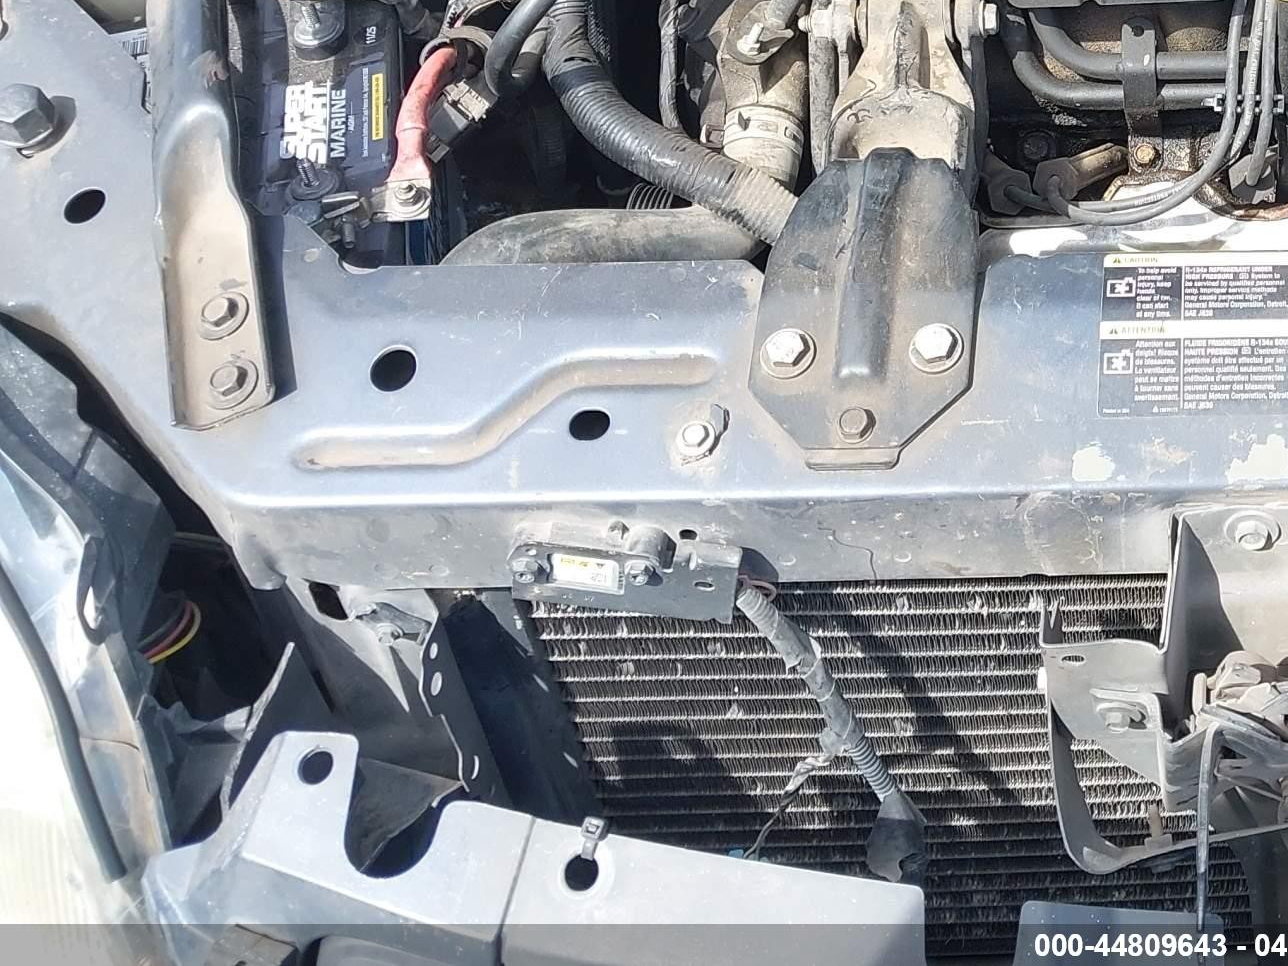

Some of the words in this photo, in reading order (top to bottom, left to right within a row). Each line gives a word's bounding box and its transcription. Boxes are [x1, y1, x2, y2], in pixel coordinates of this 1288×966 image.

[280, 84, 306, 159] SUPER
[303, 80, 328, 164] START
[330, 89, 346, 158] MARINE
[1146, 267, 1160, 275] help
[1251, 273, 1273, 281] System
[1220, 280, 1228, 288] by
[1228, 280, 1255, 288] qualified
[1199, 287, 1227, 295] Improper
[1185, 294, 1198, 302] may
[1230, 301, 1266, 309] Corporation,
[1143, 311, 1155, 319] any
[1184, 309, 1197, 317] SAE
[1136, 340, 1163, 348] Attention
[1164, 340, 1176, 348] aux
[1184, 347, 1206, 355] HAUTE
[1206, 347, 1239, 355] PRESSION
[1211, 356, 1224, 364] doit
[1264, 357, 1275, 366] par
[1275, 356, 1285, 364] un
[1184, 366, 1215, 374] personnel
[1134, 376, 1149, 384] peut
[1249, 374, 1285, 382] incorrectes
[1184, 384, 1210, 392] peuvent
[1231, 383, 1244, 391] des
[1208, 392, 1230, 400] Motors
[1230, 392, 1268, 400] Corporation,
[1184, 401, 1198, 409] SAE
